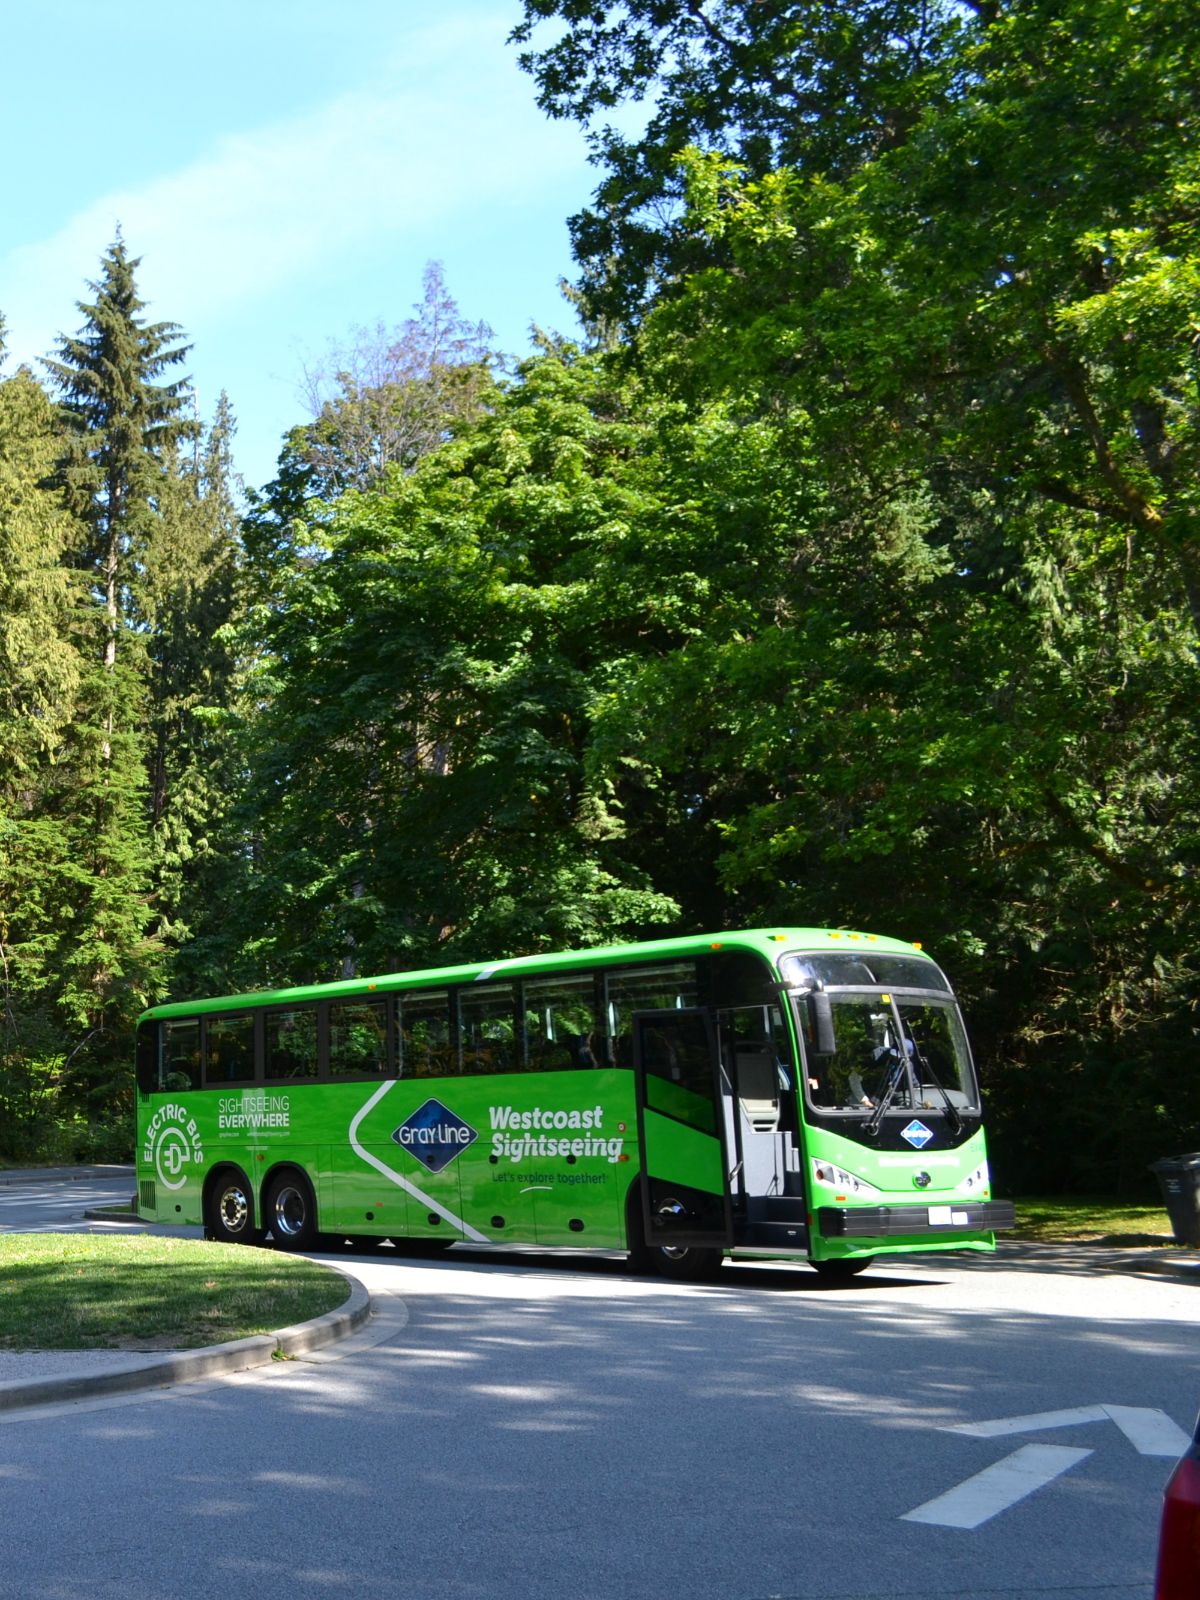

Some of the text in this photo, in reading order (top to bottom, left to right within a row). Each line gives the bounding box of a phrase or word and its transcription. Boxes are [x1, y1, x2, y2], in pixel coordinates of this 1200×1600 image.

[218, 1096, 290, 1113] SIGHTSEEING
[218, 1113, 290, 1128] EVERYWHERE
[489, 1106, 603, 1130] Westcoast
[144, 1104, 203, 1164] ELECTRIC BUS
[491, 1132, 624, 1163] Sightseeing
[492, 1171, 606, 1185] Let's explore together!
